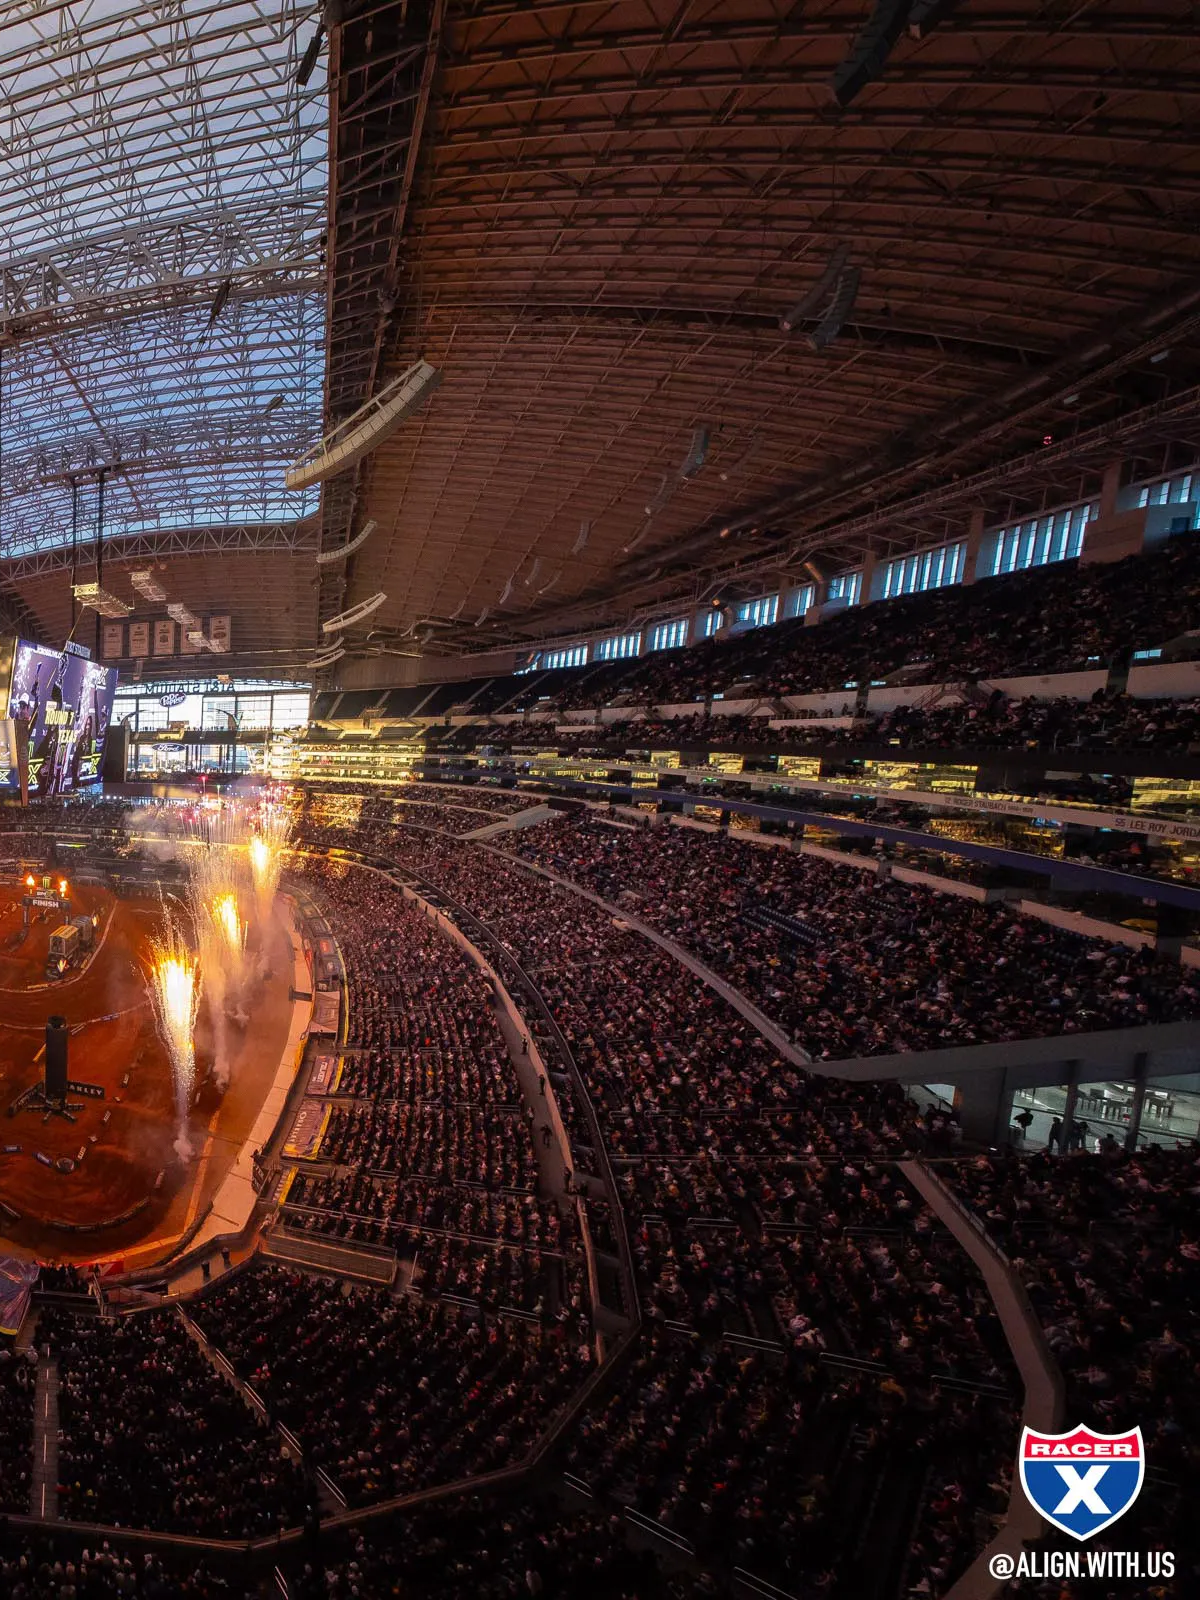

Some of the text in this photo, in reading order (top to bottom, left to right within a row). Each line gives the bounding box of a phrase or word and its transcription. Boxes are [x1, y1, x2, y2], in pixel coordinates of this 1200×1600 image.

[162, 695, 185, 706] Pepper
[45, 710, 68, 725] ROUND
[58, 729, 79, 743] TEXAS
[1115, 817, 1126, 827] 55
[1130, 820, 1146, 830] LEE
[1148, 822, 1168, 833] ROY
[32, 899, 59, 908] FINISH
[69, 1084, 103, 1096] AKLEY
